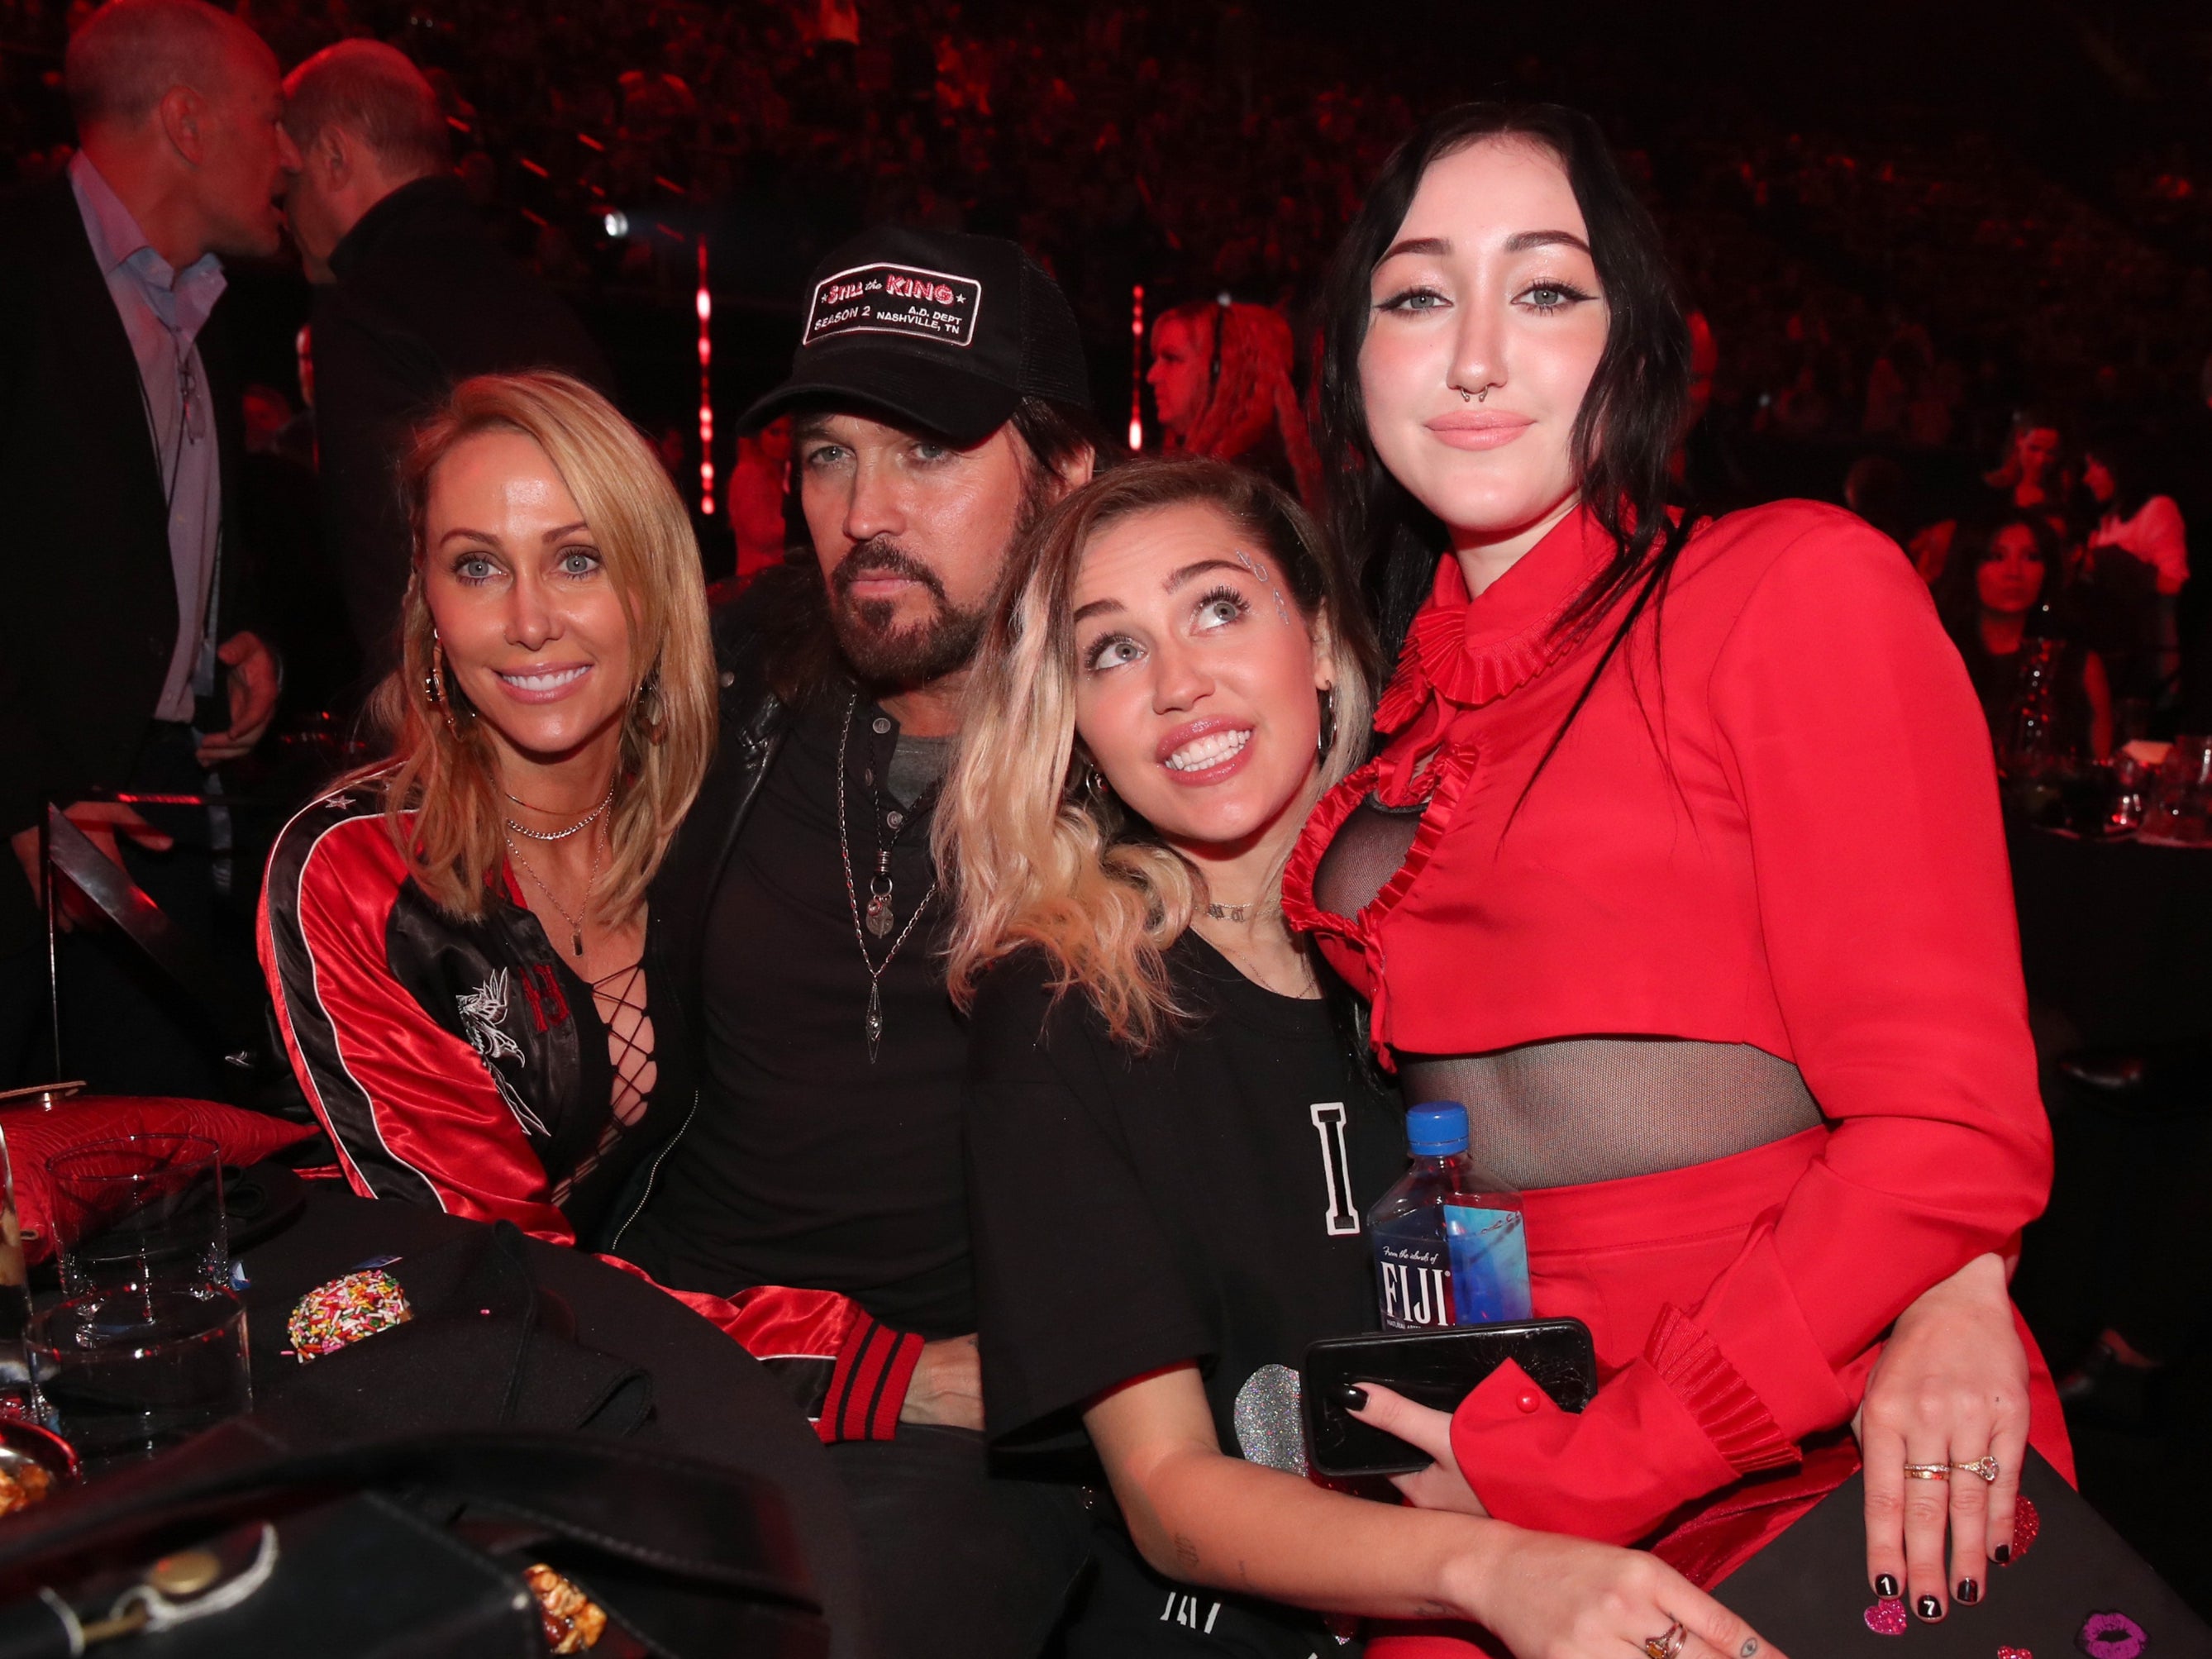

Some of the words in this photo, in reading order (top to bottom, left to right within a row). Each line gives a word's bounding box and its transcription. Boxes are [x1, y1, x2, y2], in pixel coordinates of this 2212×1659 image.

[865, 279, 883, 291] the
[886, 274, 954, 305] KING
[814, 307, 859, 331] SEASON
[861, 305, 871, 317] 2
[876, 312, 941, 331] NASHVILLE,
[945, 323, 960, 334] TN
[908, 306, 929, 317] A.D.
[932, 311, 962, 325] DEPT
[1309, 1102, 1361, 1236] I
[1399, 1248, 1409, 1260] the
[1881, 1576, 1891, 1595] 1
[1924, 1599, 1935, 1616] 7
